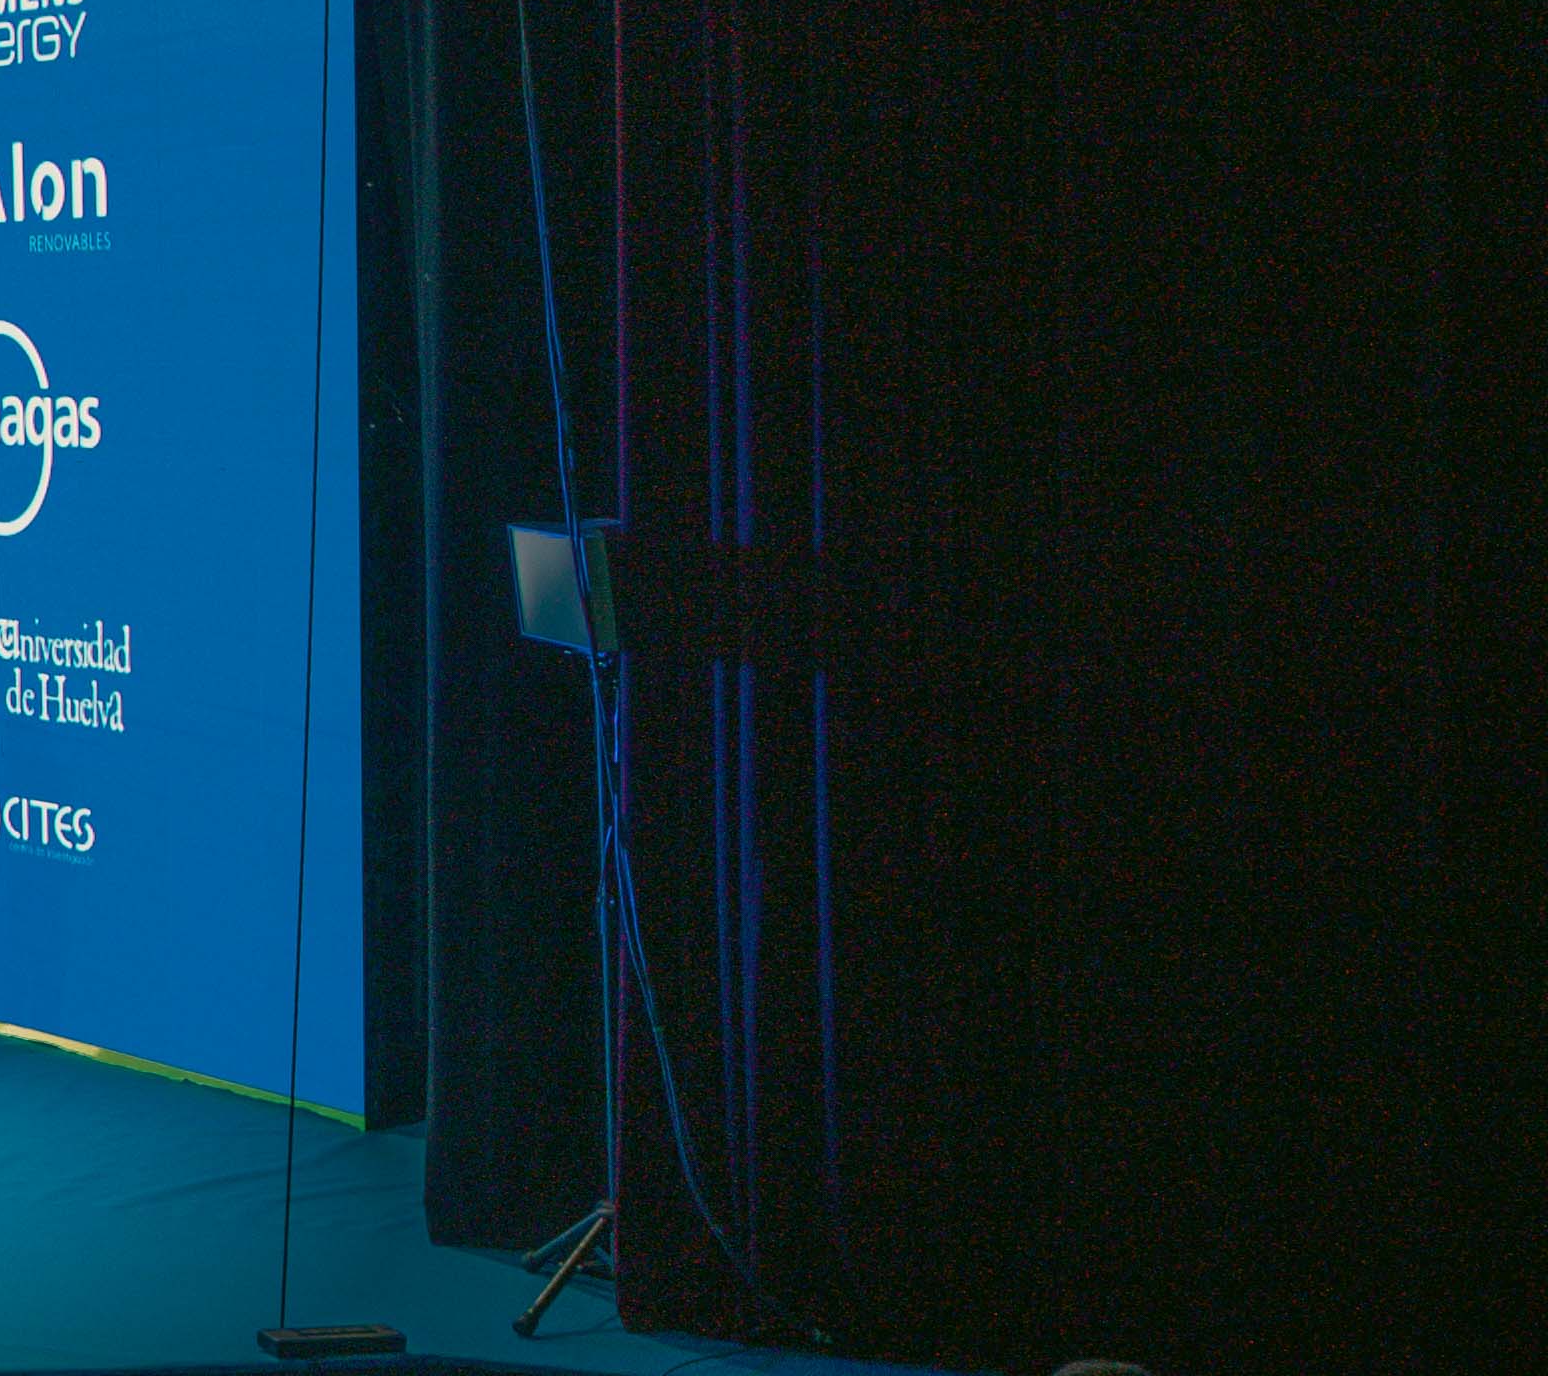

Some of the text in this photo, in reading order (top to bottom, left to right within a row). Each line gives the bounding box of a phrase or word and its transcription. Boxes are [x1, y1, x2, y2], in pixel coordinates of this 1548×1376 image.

[29, 232, 111, 253] RENOVABLES
[6, 667, 124, 732] de Huelva
[2, 796, 96, 852] CITES
